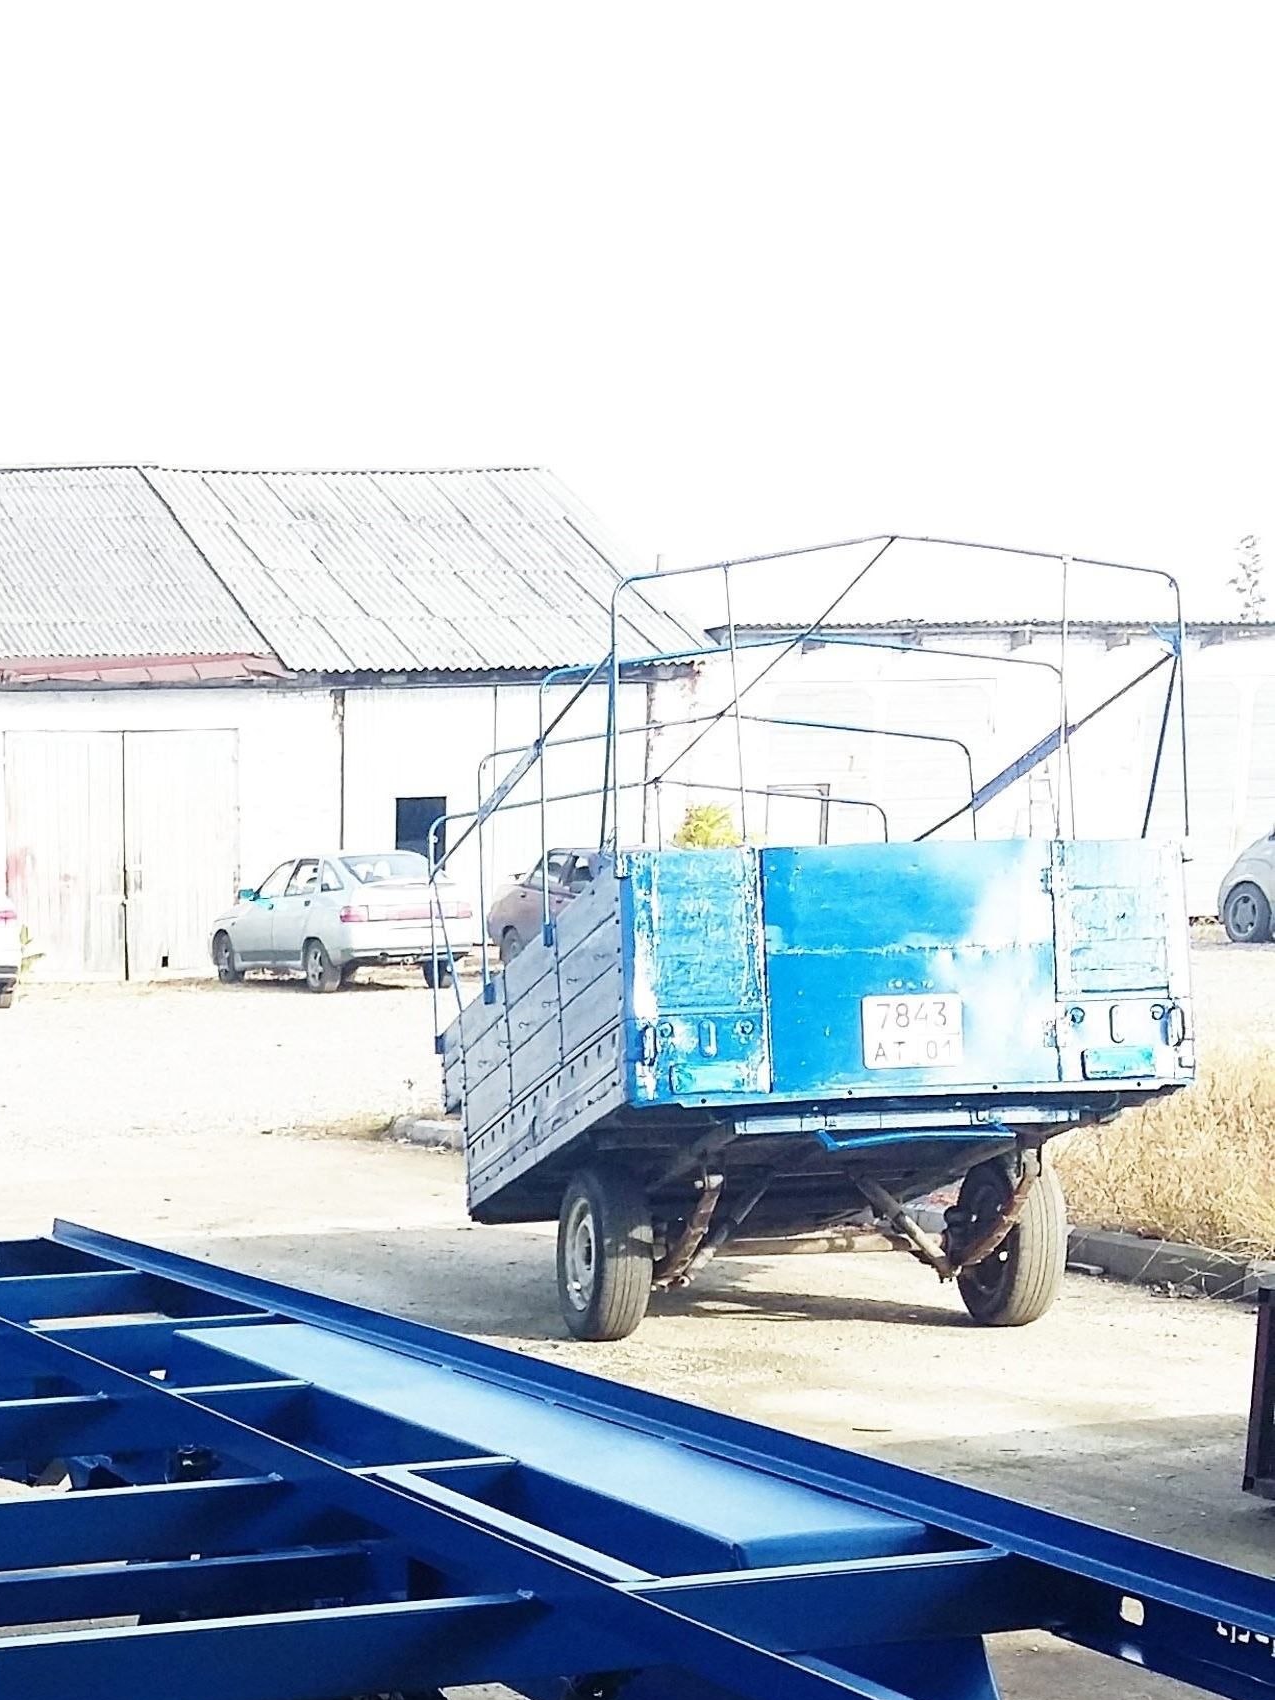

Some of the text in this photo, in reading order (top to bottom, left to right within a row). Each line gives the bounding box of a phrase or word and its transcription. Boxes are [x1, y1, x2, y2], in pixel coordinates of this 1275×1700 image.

[876, 1001, 947, 1029] 7843
[874, 1039, 951, 1062] AT 01
